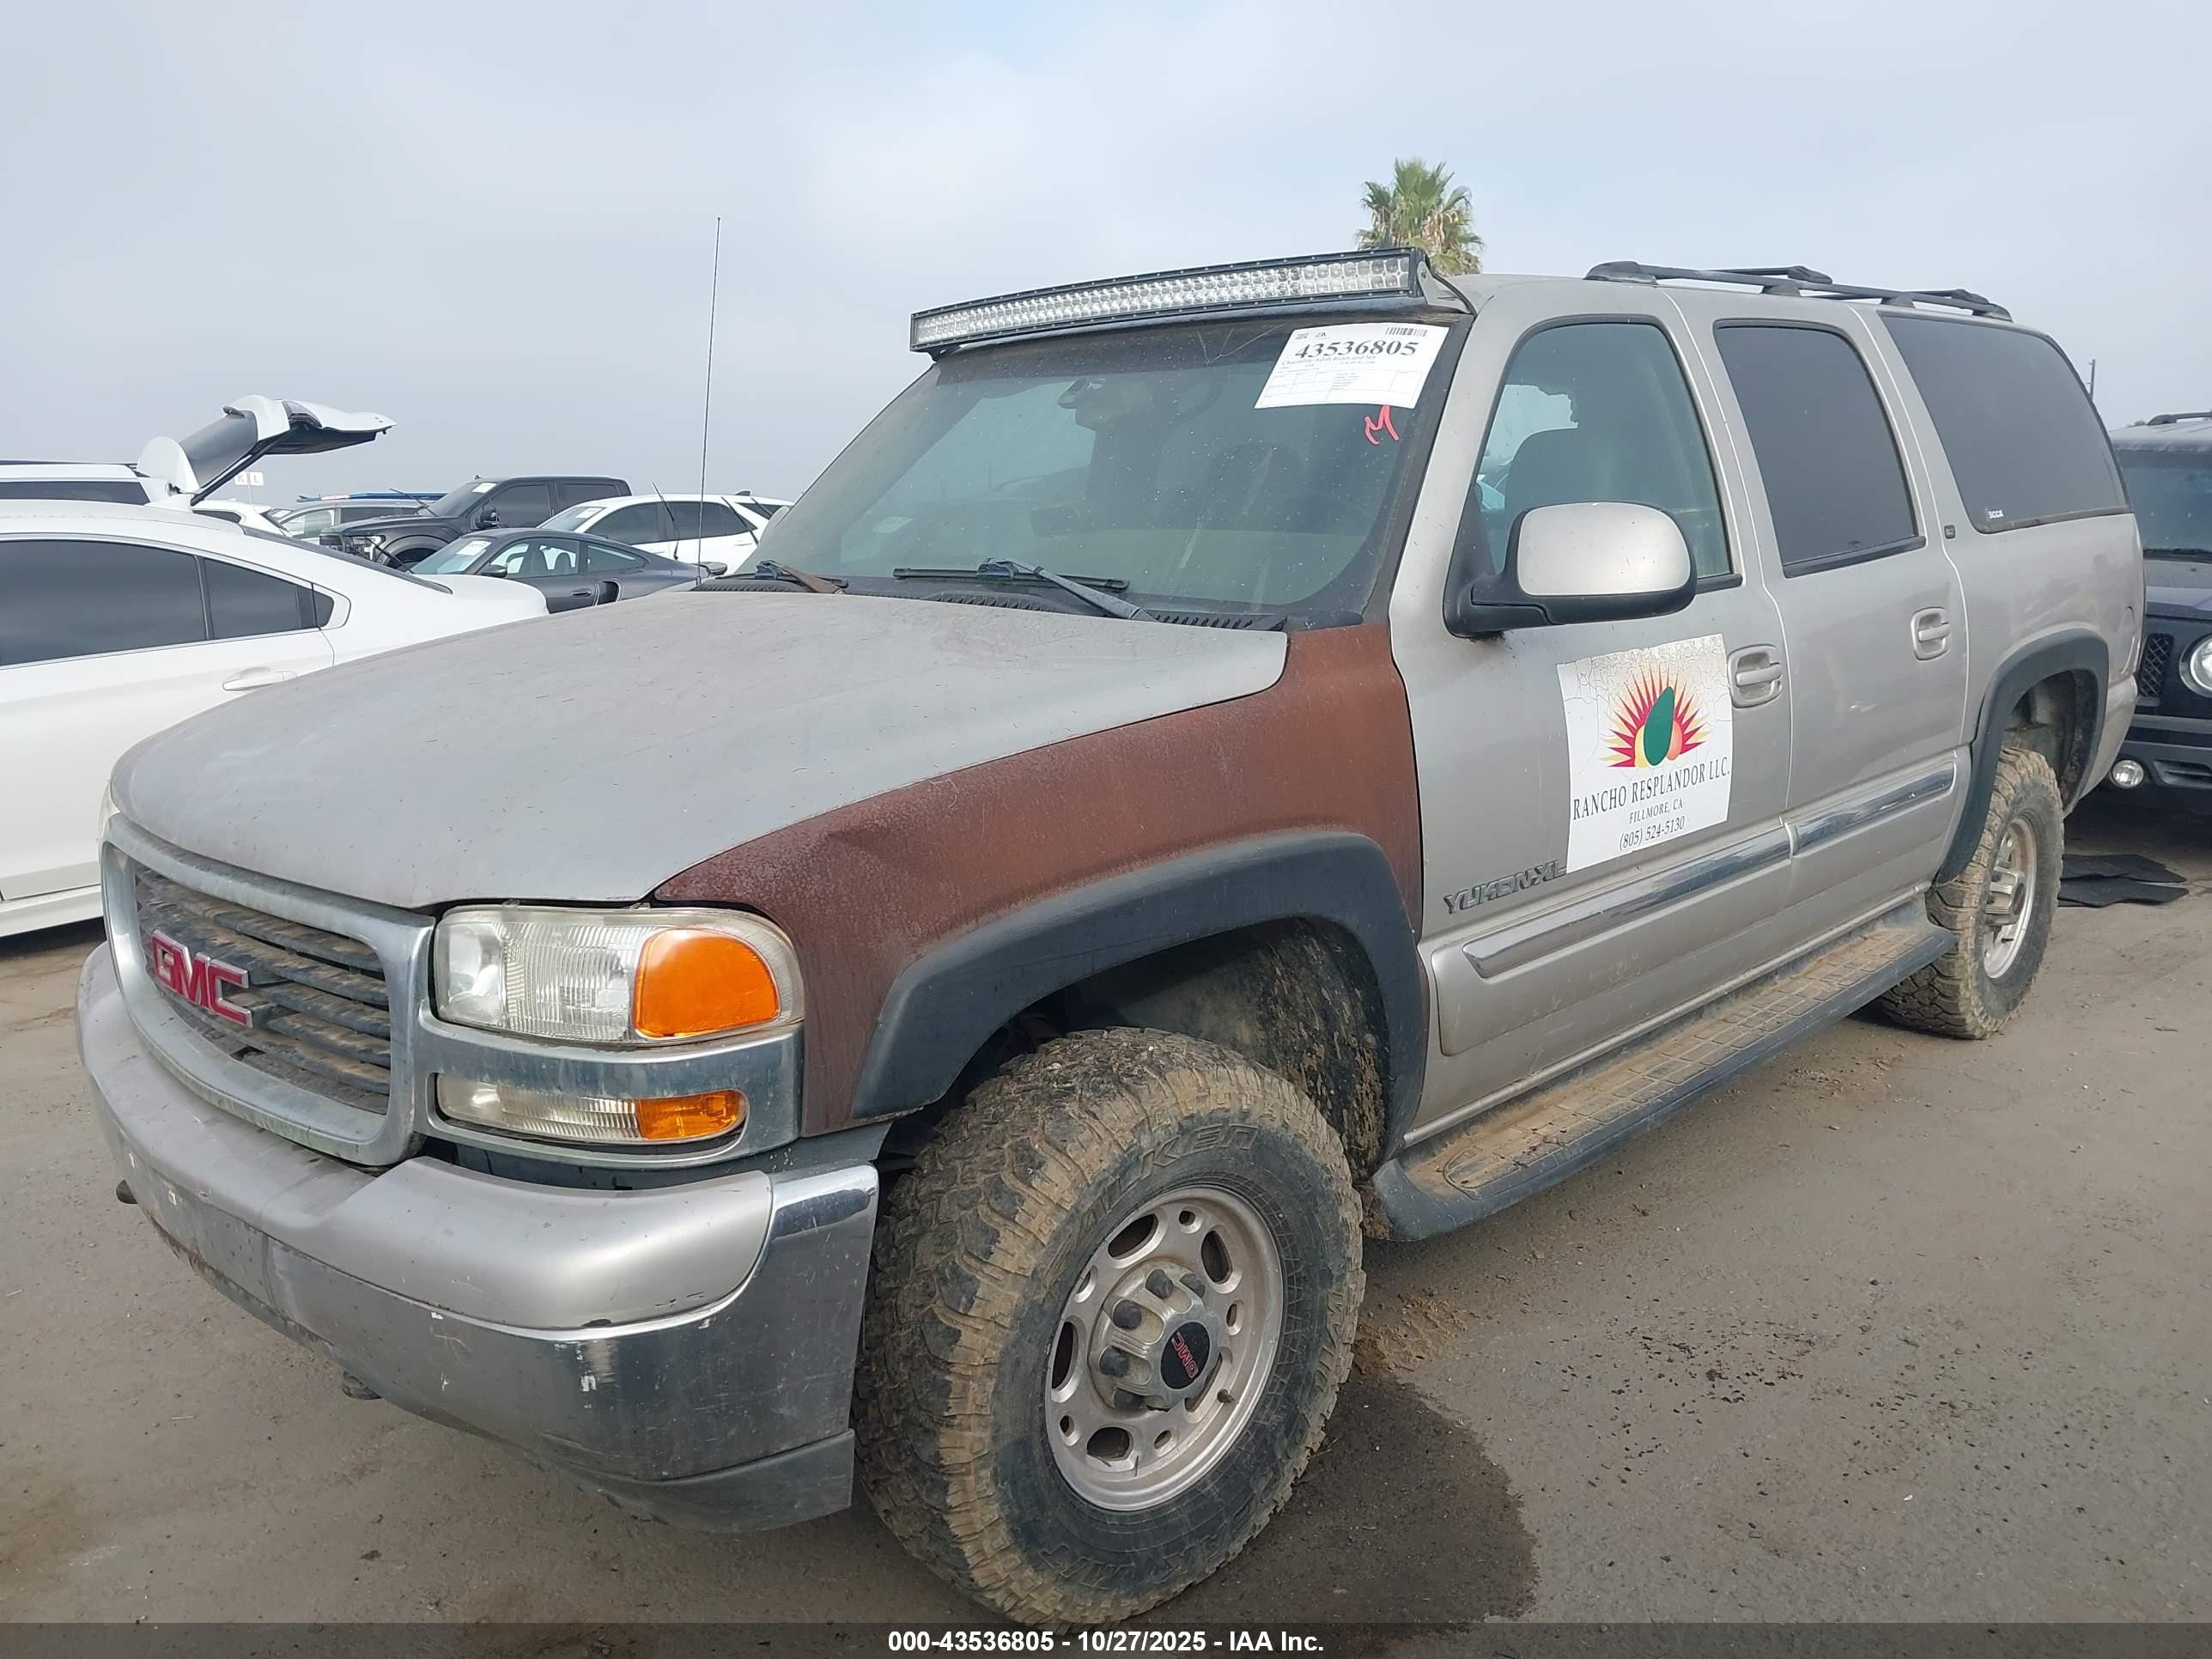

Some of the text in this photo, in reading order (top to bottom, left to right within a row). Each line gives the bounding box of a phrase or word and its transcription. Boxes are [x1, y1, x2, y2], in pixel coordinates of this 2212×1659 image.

[1295, 340, 1419, 359] 43536805
[1573, 786, 1627, 821] RANCHO
[1632, 763, 1706, 804] RESPLANDOR
[1629, 797, 1684, 824] FILLMORE, CA
[1620, 815, 1686, 852] (805) 524-5130
[150, 929, 253, 1028] GMC
[1170, 1331, 1199, 1379] GMC
